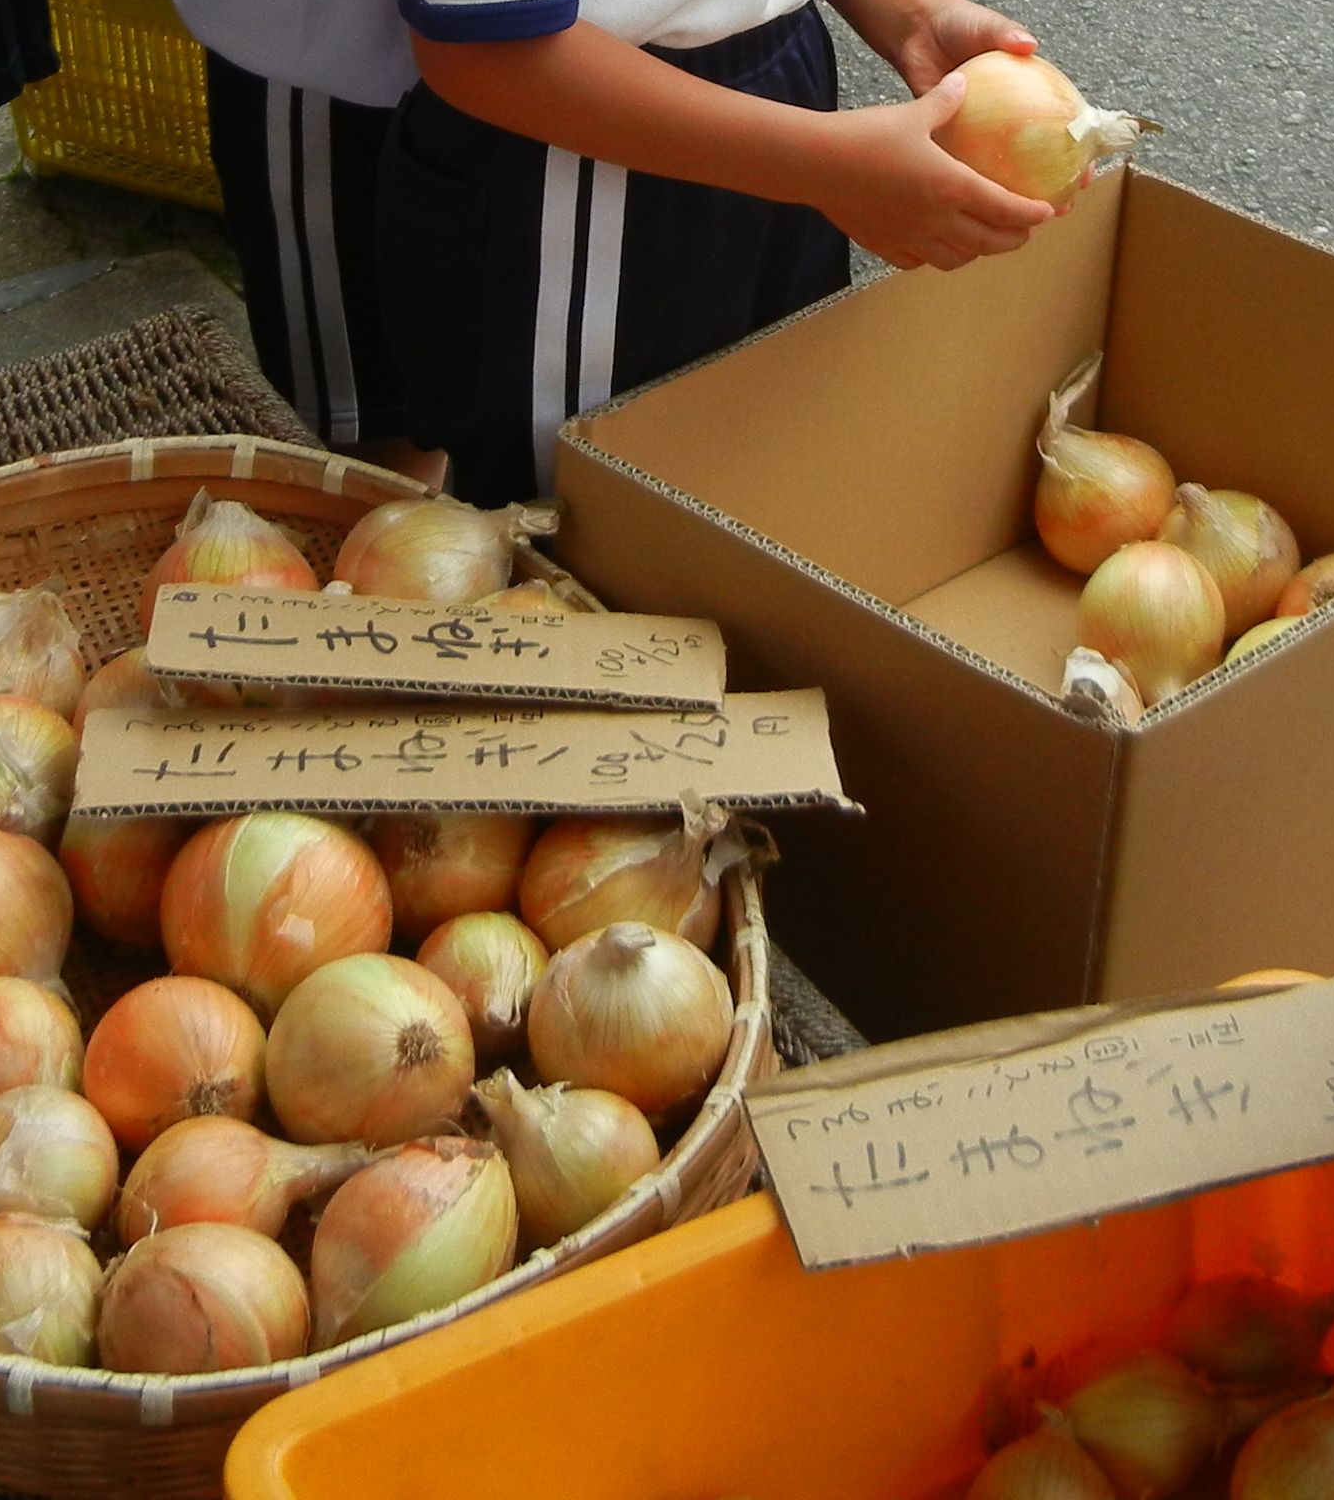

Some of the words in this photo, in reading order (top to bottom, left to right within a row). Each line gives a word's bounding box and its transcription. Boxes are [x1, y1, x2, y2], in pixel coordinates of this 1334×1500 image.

[188, 612, 551, 660] たまねぎ
[132, 728, 569, 782] たまねぎ
[808, 1061, 1254, 1207] たまねぎ
